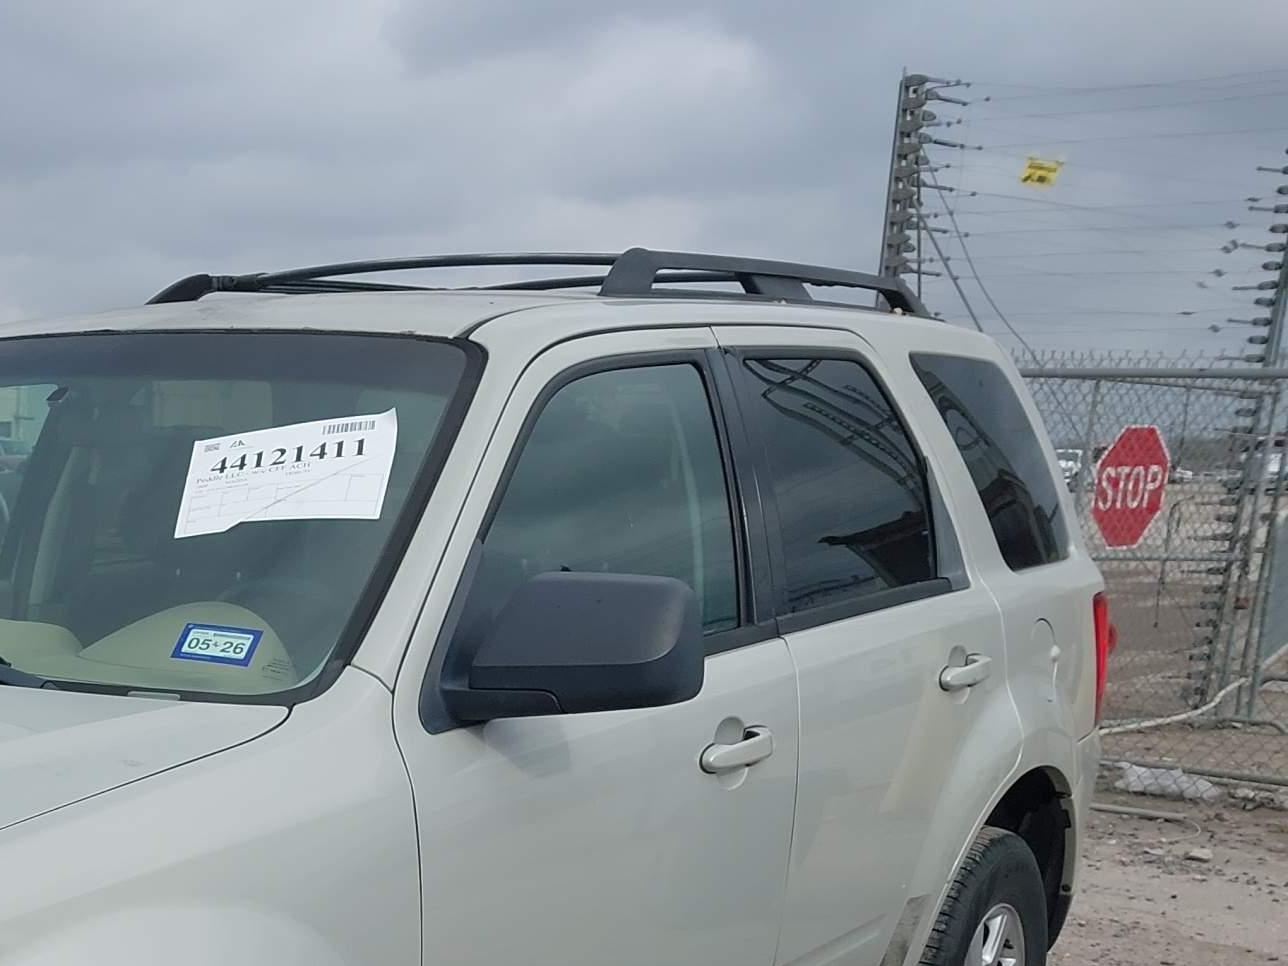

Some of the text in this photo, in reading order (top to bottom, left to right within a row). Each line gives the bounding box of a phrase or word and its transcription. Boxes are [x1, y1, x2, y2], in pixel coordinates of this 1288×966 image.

[210, 438, 365, 474] 44121411
[1097, 464, 1163, 512] STOP
[187, 637, 213, 651] 05
[219, 641, 246, 655] 26
